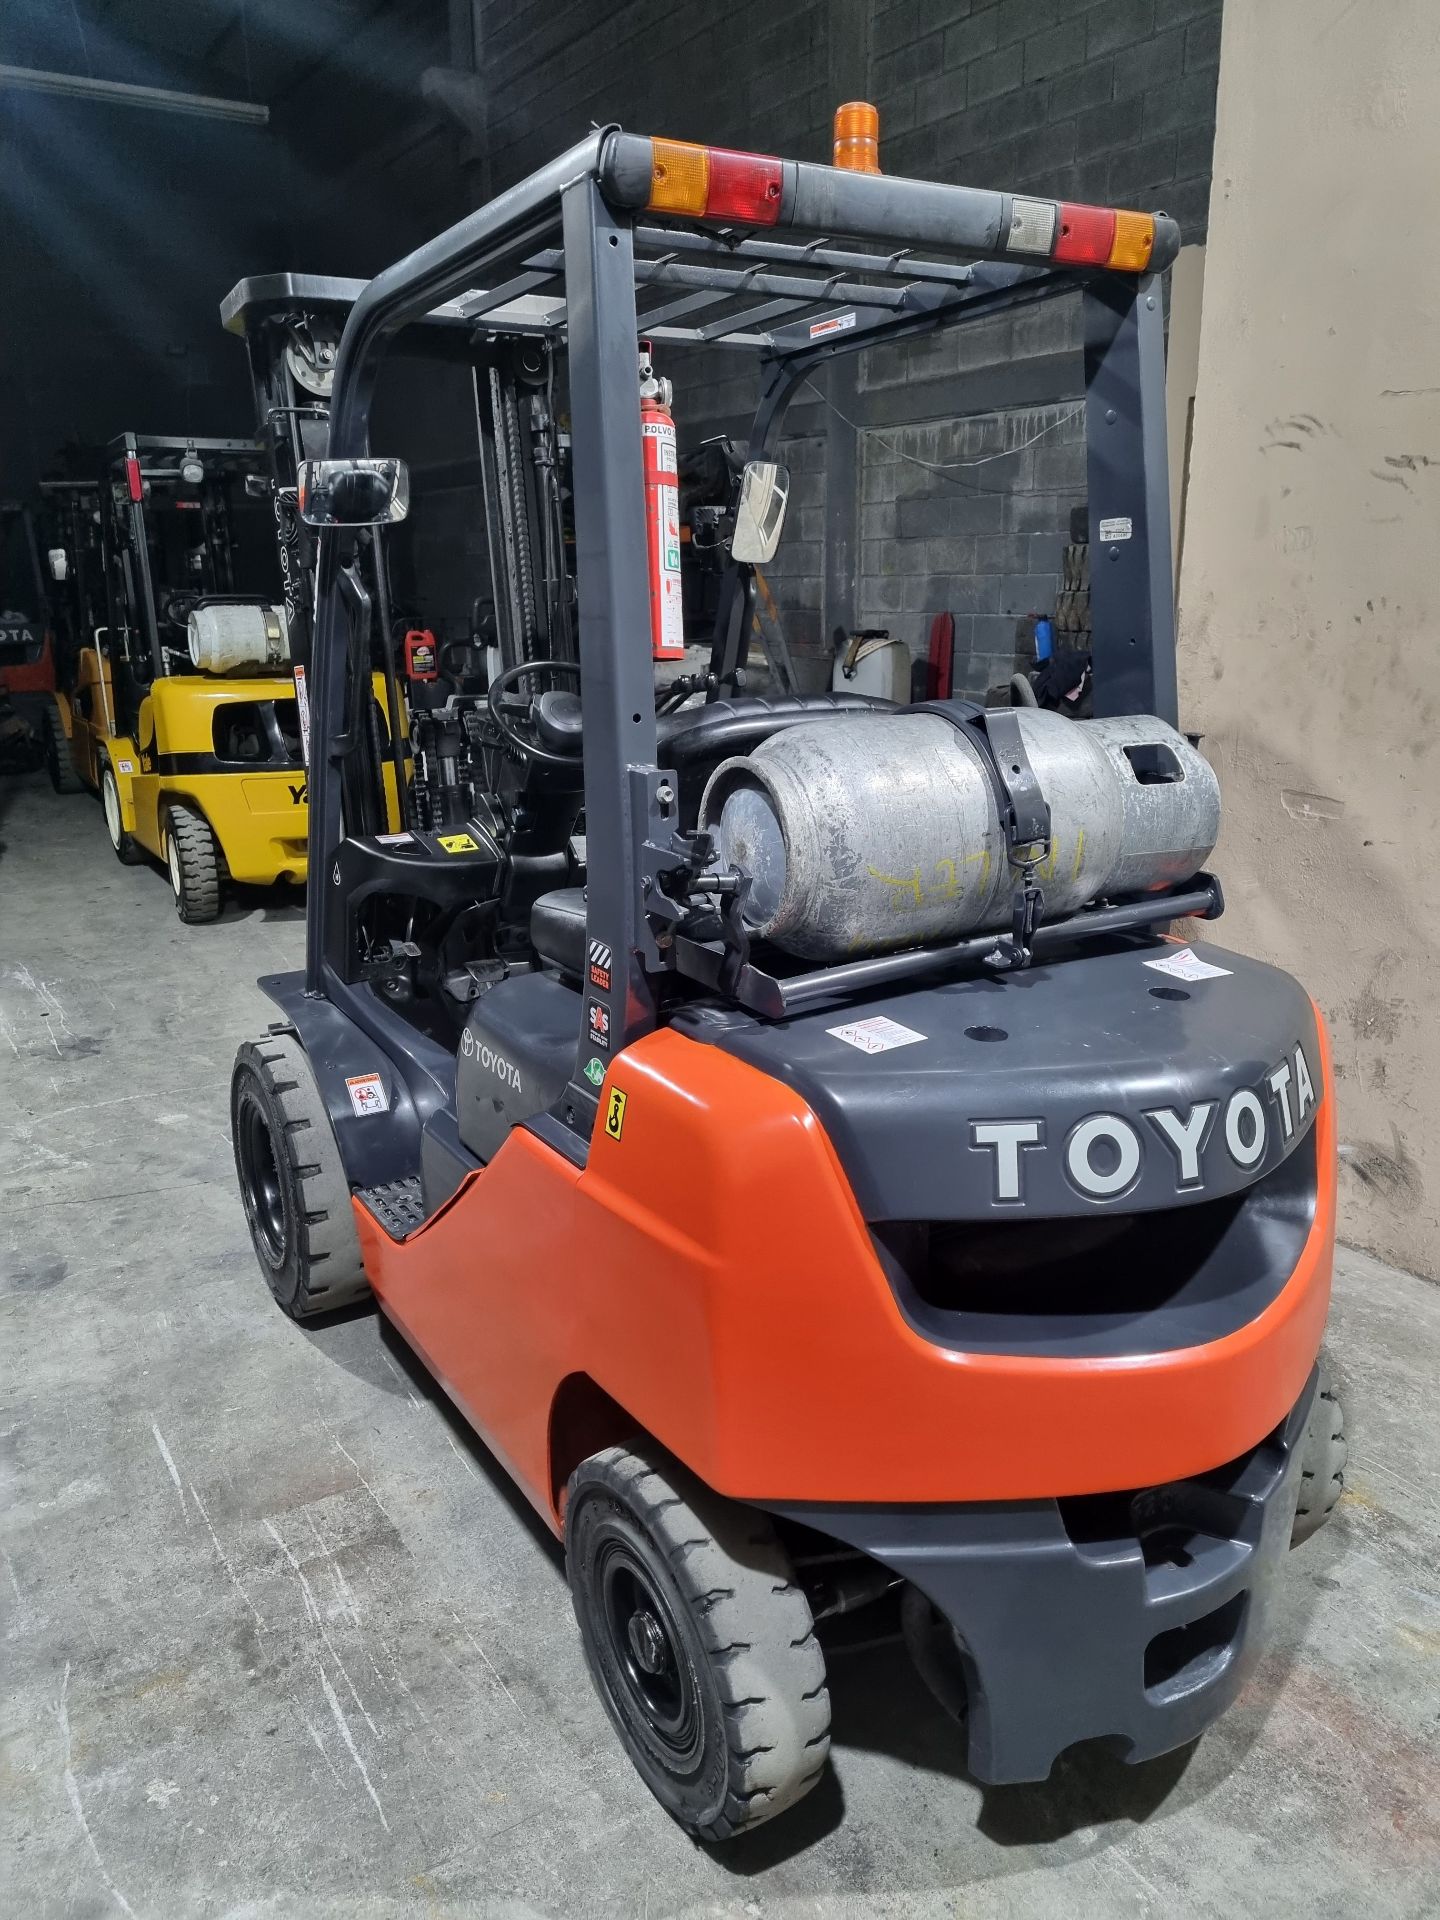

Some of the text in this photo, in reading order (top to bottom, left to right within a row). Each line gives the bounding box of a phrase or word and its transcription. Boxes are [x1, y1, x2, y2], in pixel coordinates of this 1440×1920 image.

[644, 425, 672, 436] POLVO
[590, 974, 609, 990] LEADER
[591, 965, 610, 980] SAFETY
[589, 1006, 609, 1034] SAS
[475, 1039, 522, 1094] TOYOTA
[974, 1044, 1317, 1200] TOYOTA
